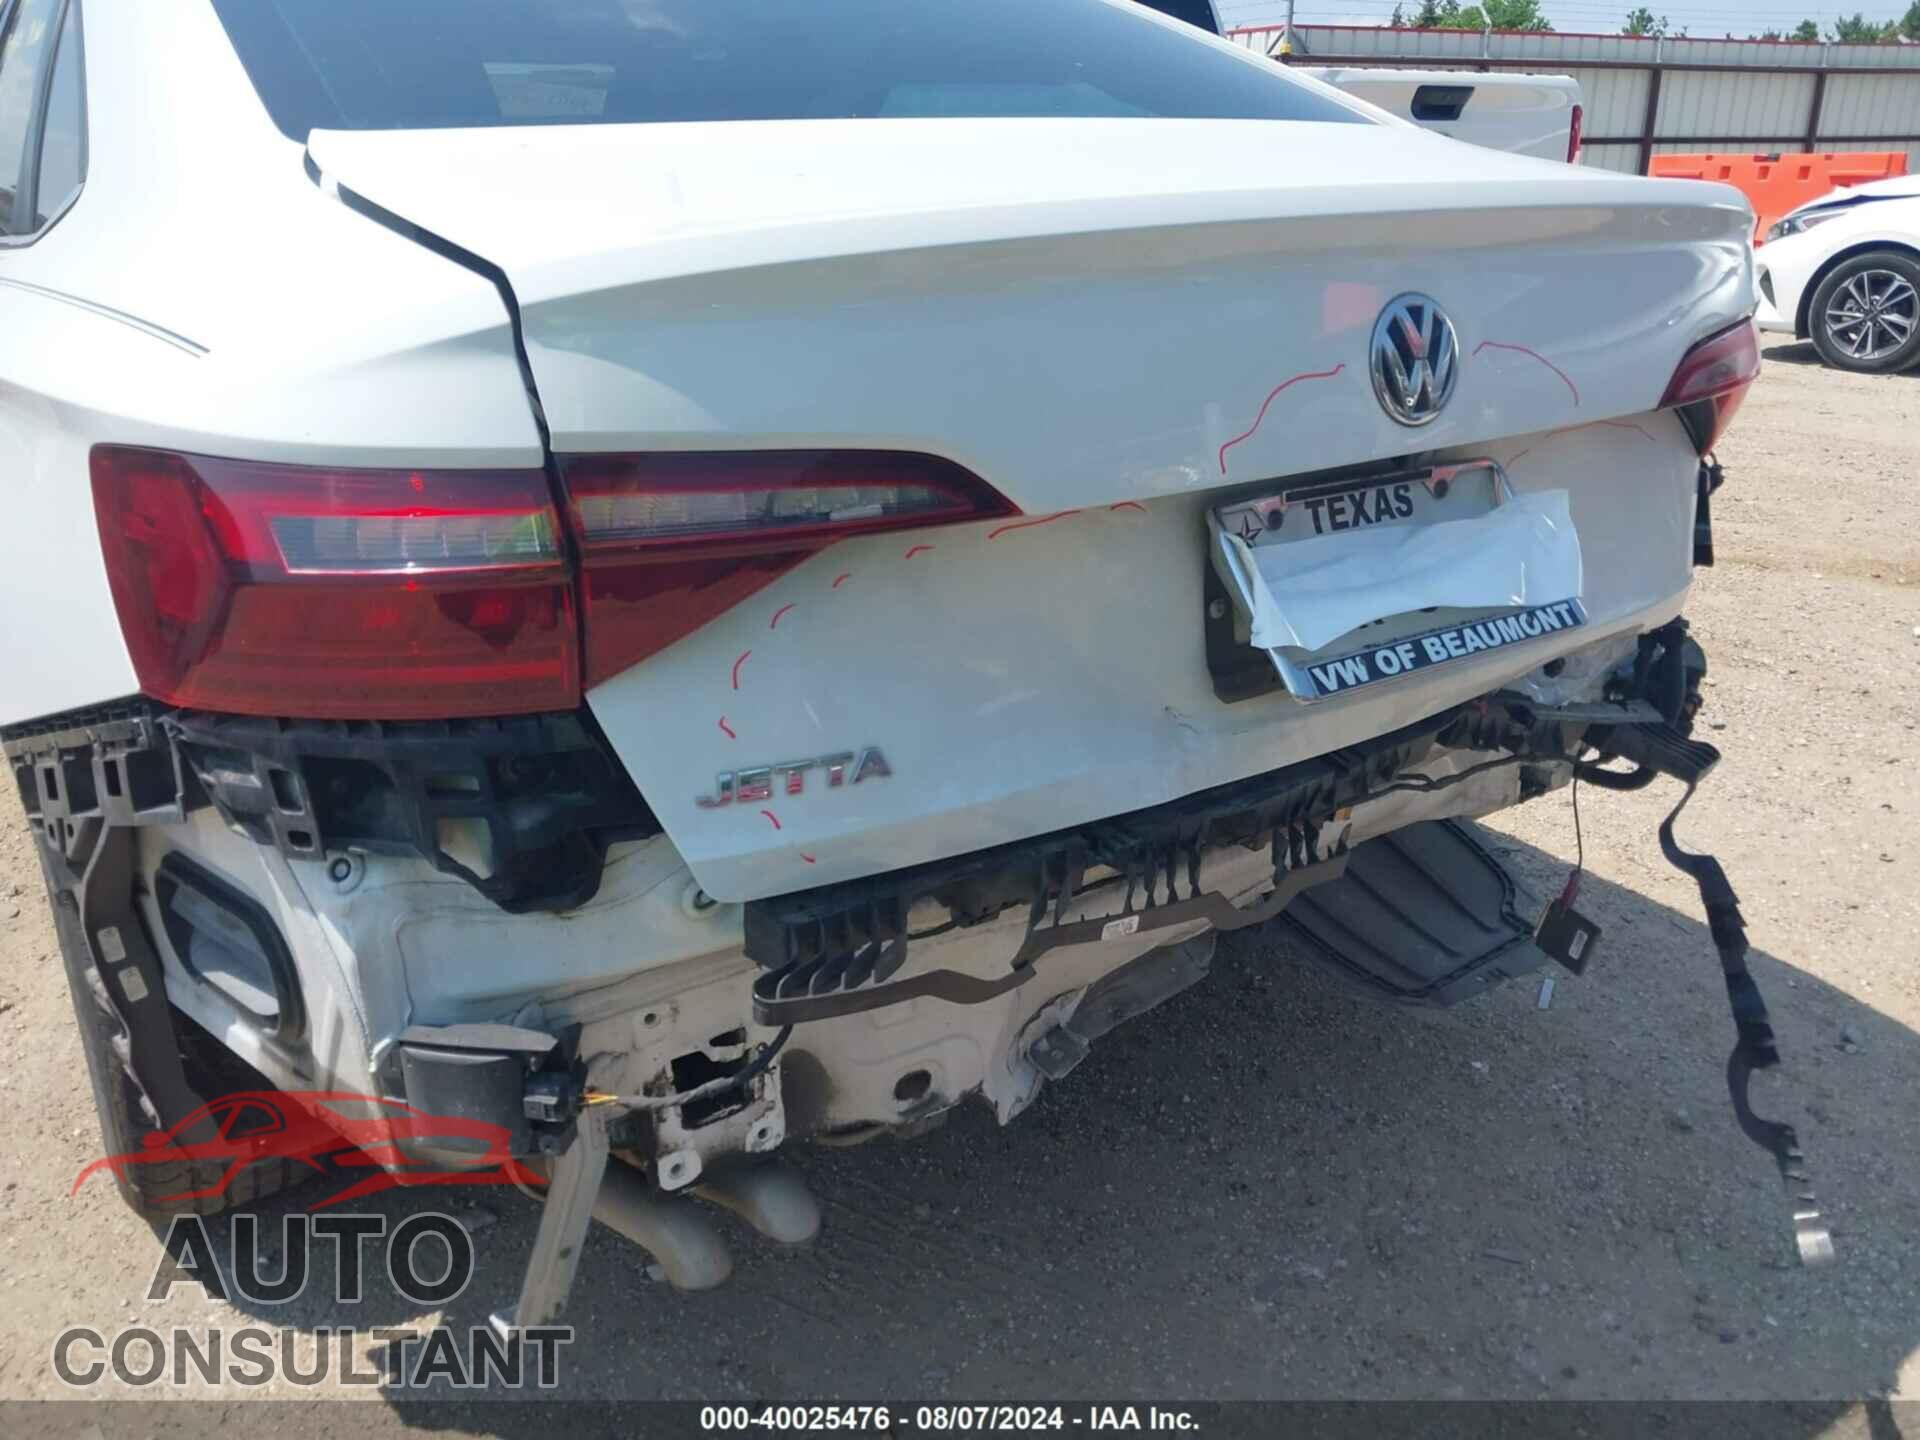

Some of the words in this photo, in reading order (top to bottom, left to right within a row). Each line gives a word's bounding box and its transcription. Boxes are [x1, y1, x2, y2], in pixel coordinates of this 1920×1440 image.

[1304, 484, 1414, 534] TEXAS
[1312, 656, 1370, 692] VW
[1374, 642, 1416, 675] OF
[1421, 601, 1575, 663] BEAUMONT
[696, 746, 892, 809] JETTA
